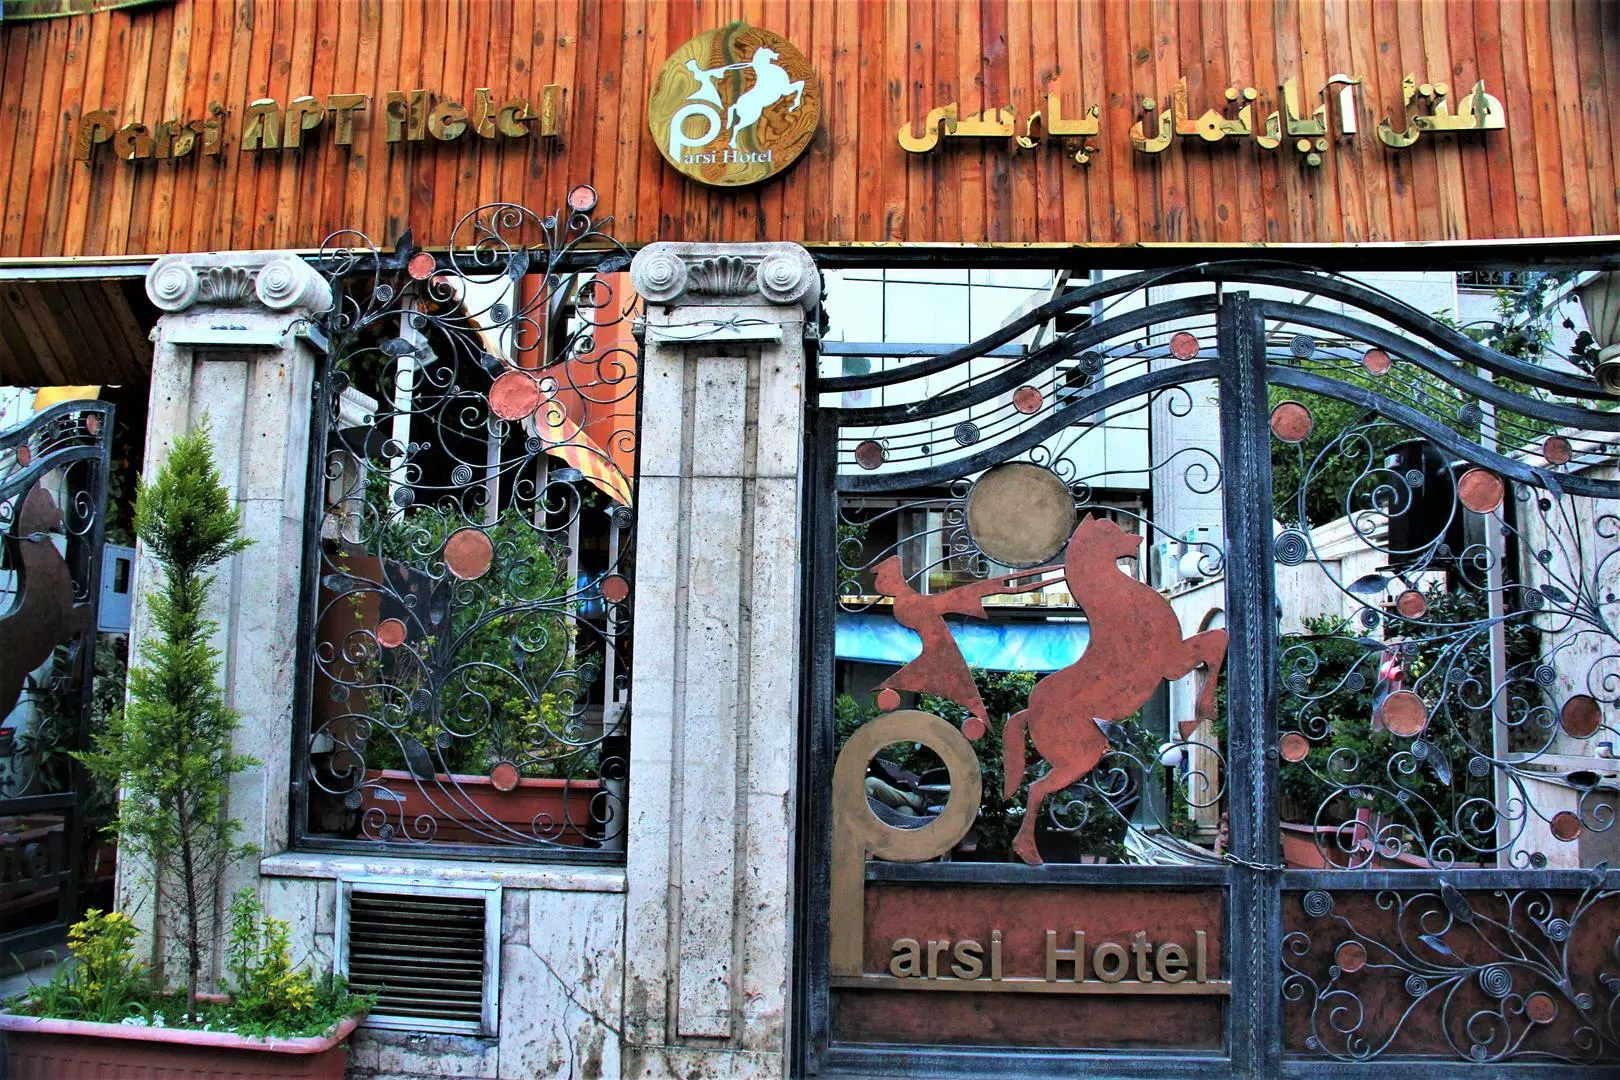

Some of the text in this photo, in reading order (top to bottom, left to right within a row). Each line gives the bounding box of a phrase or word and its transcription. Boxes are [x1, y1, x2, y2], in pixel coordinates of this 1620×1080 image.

[386, 83, 562, 142] Hotel
[1129, 73, 1363, 166] آپارتمان
[1379, 72, 1507, 148] هتل
[723, 149, 773, 164] Hotel
[1045, 929, 1208, 984] Hotel
